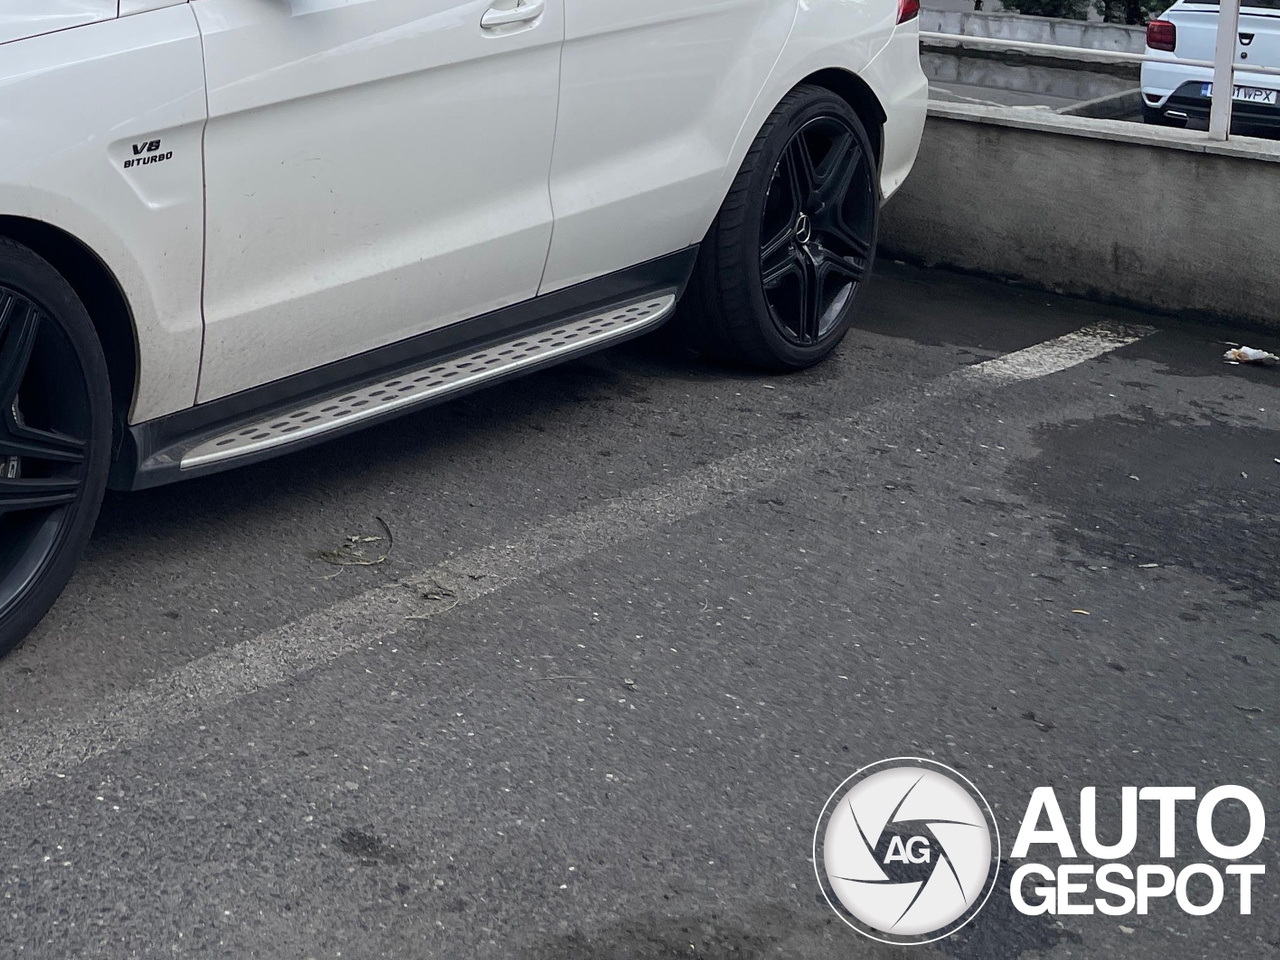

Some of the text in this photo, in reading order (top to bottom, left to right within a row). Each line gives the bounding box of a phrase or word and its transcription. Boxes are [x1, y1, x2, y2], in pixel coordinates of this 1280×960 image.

[1243, 87, 1272, 102] WPX
[132, 139, 161, 155] V8
[123, 150, 173, 168] BITURBO
